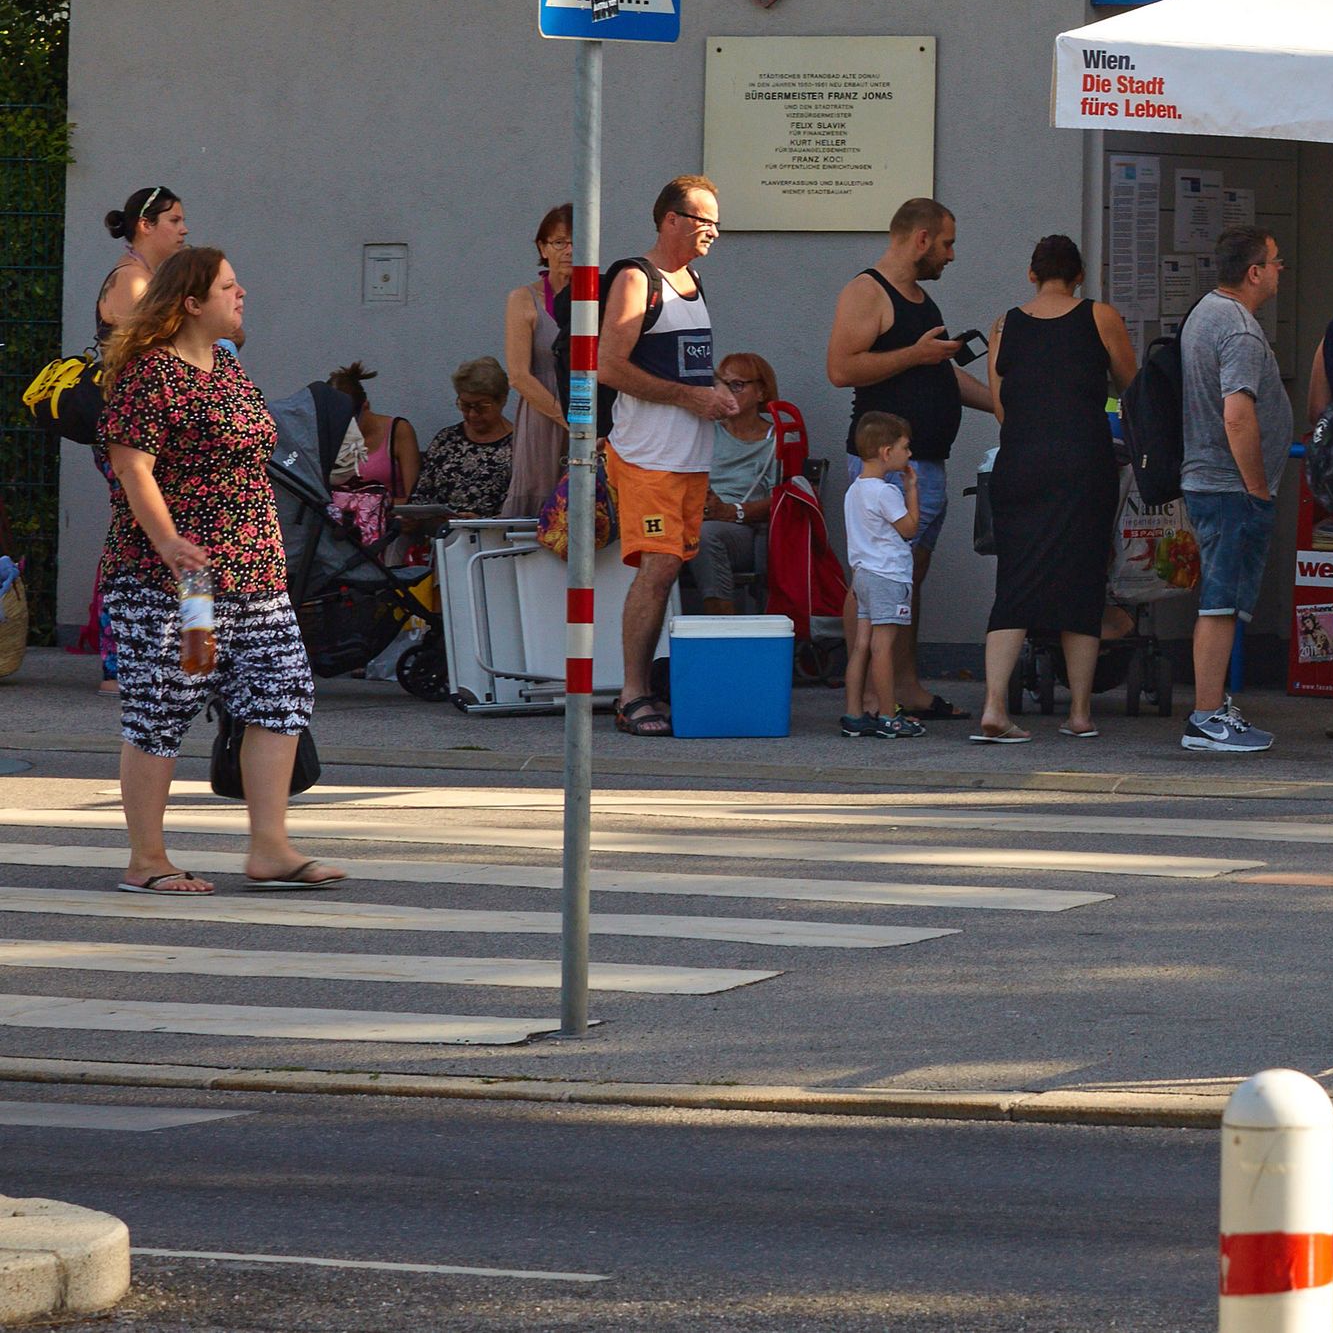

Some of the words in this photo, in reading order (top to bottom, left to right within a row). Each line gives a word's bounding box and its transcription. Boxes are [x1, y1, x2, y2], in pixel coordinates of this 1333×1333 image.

[1082, 49, 1136, 70] Wien.
[1082, 73, 1112, 93] Die
[1116, 75, 1166, 95] Stadt
[744, 90, 824, 100] BÜRGERMEISTER
[827, 90, 858, 100] FRANZ
[862, 90, 893, 100] JONAS
[1081, 97, 1119, 117] fürs
[1124, 98, 1182, 119] Leben.
[645, 519, 662, 533] H
